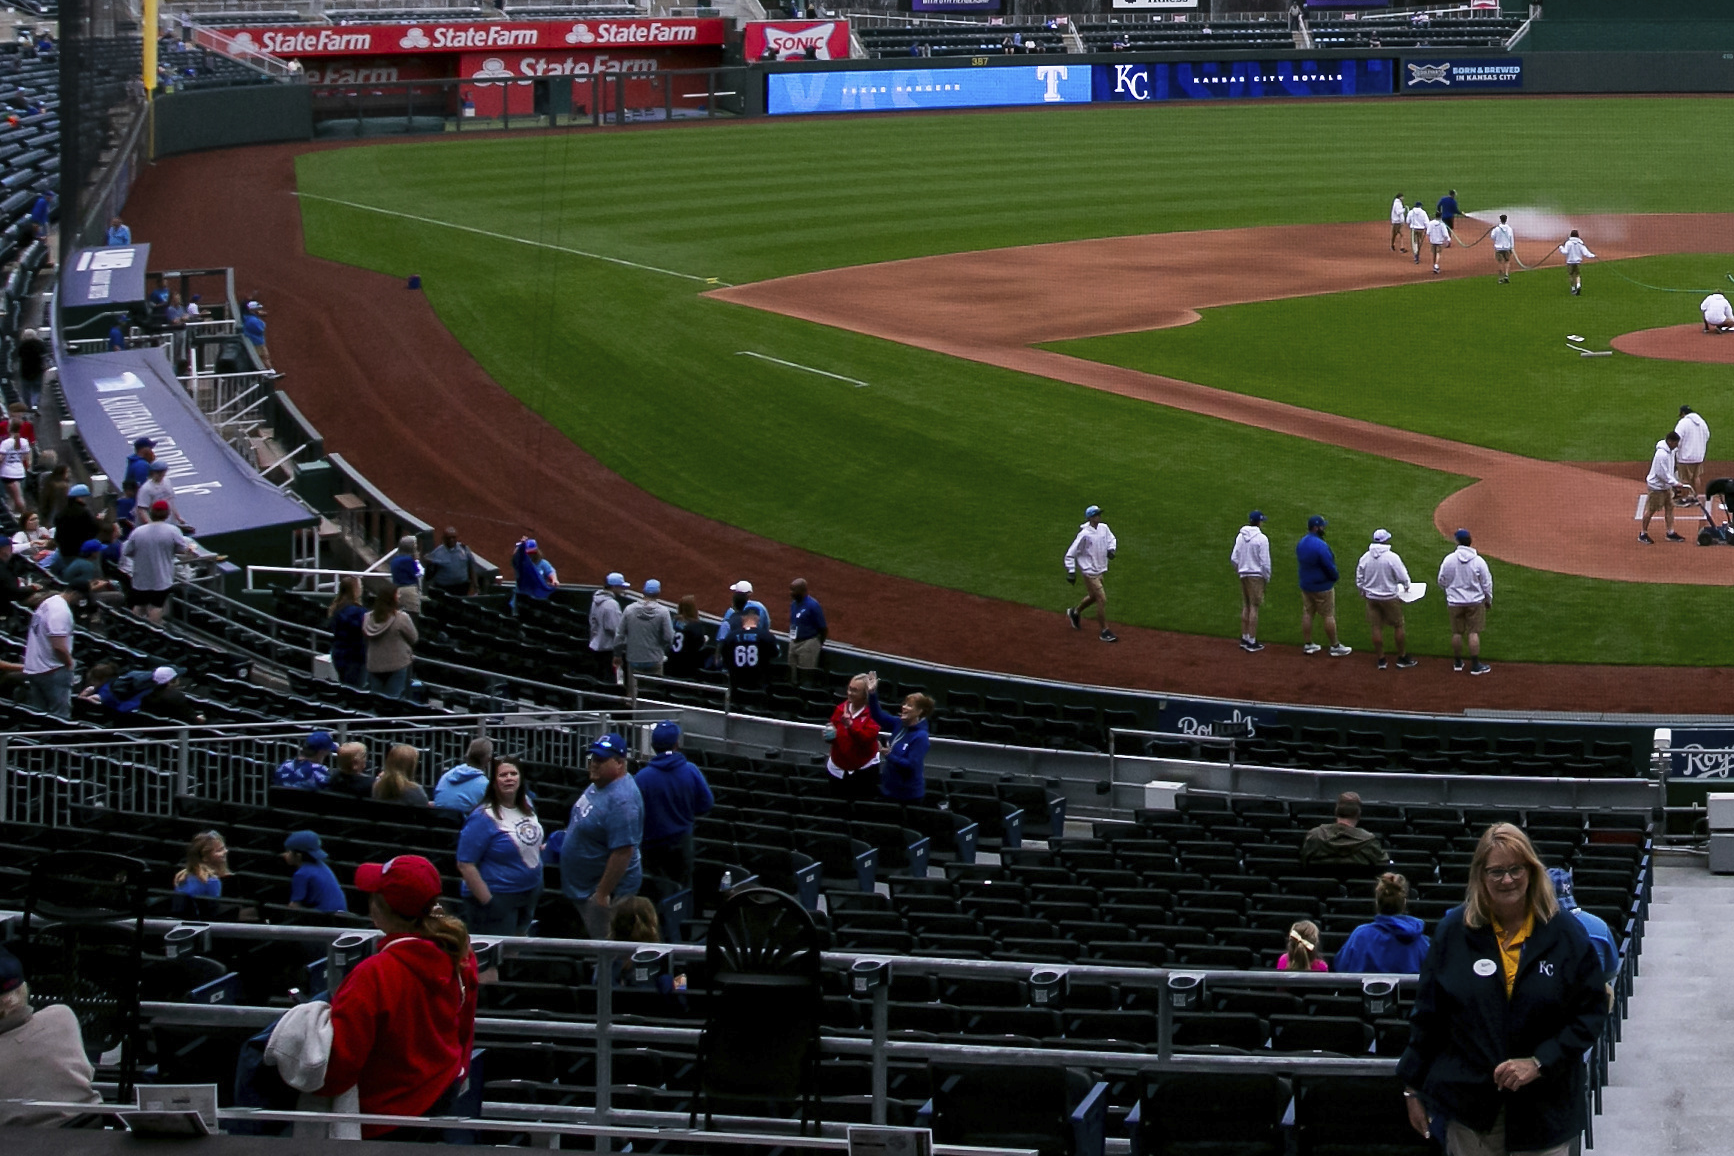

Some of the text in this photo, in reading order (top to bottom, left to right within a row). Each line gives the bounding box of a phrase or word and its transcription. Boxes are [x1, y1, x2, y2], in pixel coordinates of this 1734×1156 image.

[772, 36, 825, 51] SONIC
[971, 57, 989, 66] 387
[1453, 66, 1520, 75] BORN & BREWED
[1114, 64, 1149, 100] KC
[1193, 74, 1344, 84] KANSAS CITY ROYALS
[842, 84, 961, 94] TEXAS RANGERS
[735, 645, 758, 667] 68
[1539, 961, 1554, 976] KC
